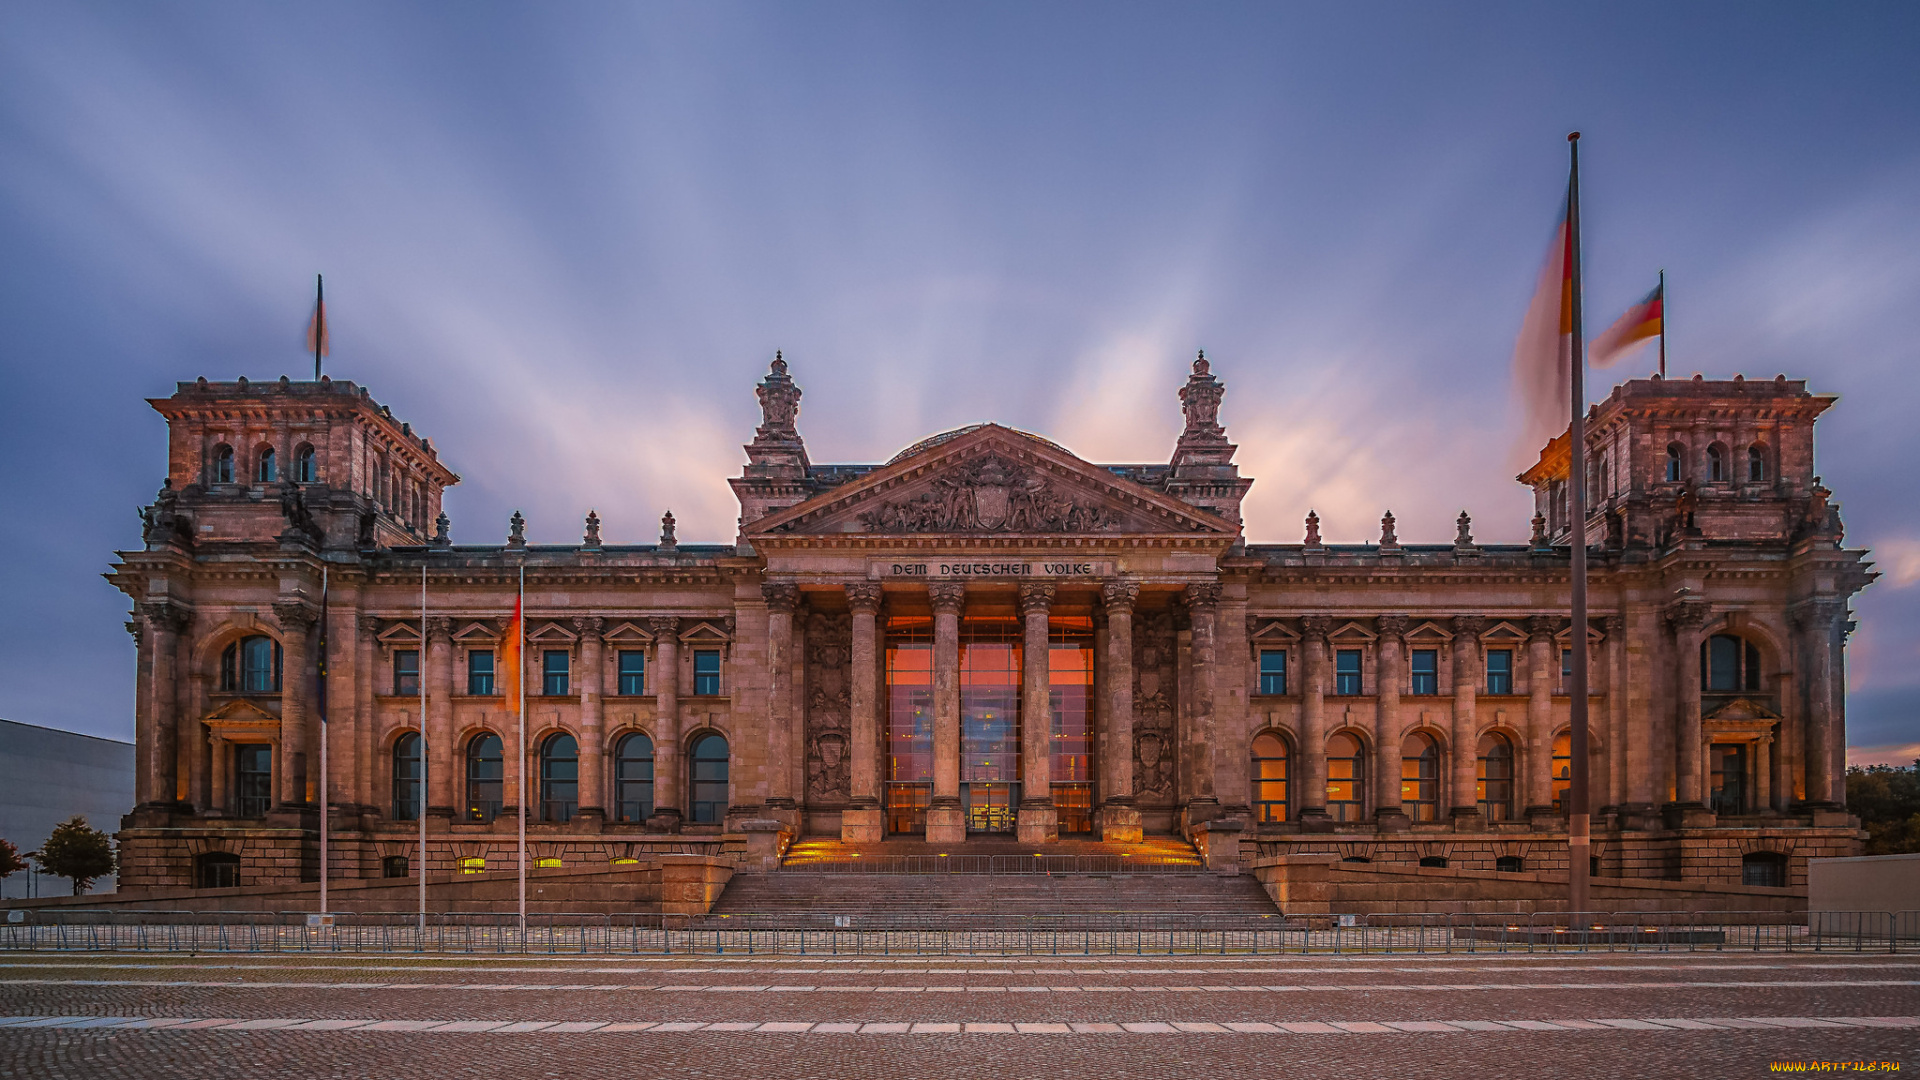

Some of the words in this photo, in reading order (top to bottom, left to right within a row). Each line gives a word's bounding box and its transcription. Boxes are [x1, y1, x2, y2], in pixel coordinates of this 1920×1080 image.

[892, 563, 928, 575] DEM
[940, 563, 1032, 575] DEUTSCHEN
[1044, 563, 1091, 575] VOLKE
